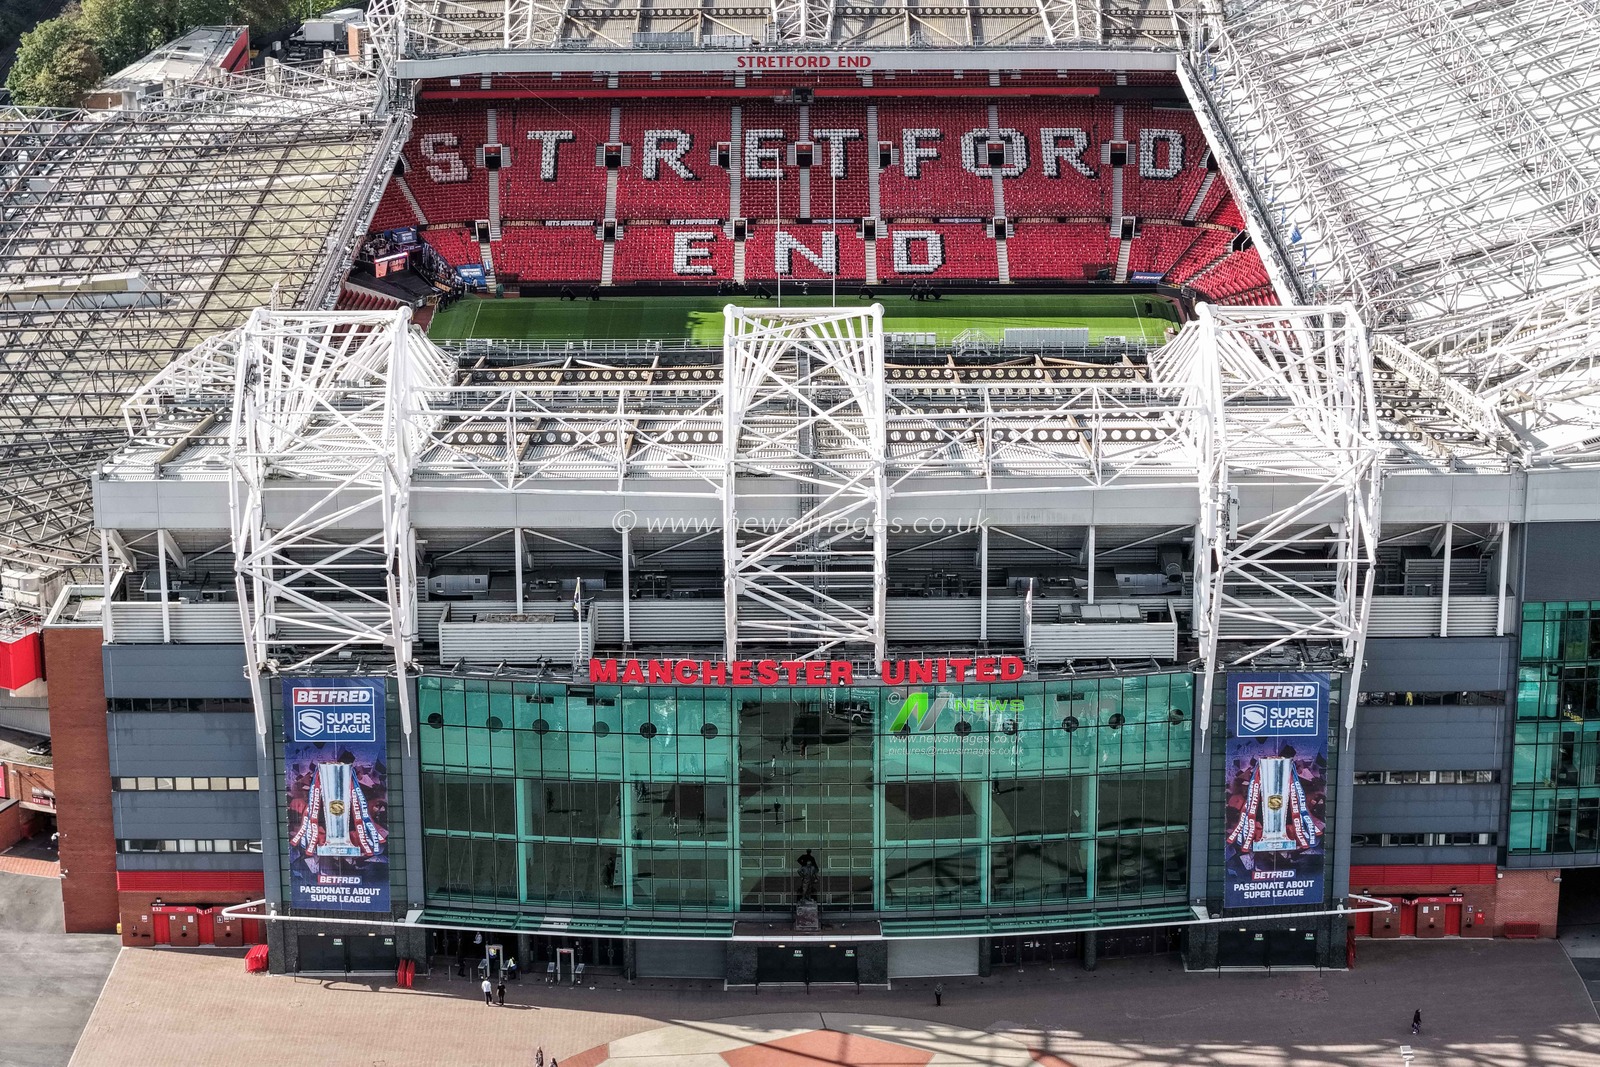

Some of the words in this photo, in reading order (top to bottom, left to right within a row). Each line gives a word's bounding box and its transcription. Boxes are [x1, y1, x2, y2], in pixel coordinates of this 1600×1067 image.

[737, 56, 831, 68] STRETFORD
[838, 56, 872, 68] END
[420, 127, 1186, 183] STRETFORD
[673, 229, 945, 276] END
[589, 658, 853, 685] MANCHESTER
[882, 656, 1024, 685] UNITED
[297, 690, 370, 703] BETFRED
[1241, 685, 1315, 698] BETFRED
[326, 712, 371, 724] SUPER
[1270, 707, 1314, 719] SUPER
[326, 724, 371, 734] LEAGUE
[1270, 719, 1314, 728] LEAGUE
[312, 788, 320, 819] BETFRED
[356, 787, 369, 818] BETFRED
[1249, 783, 1259, 814] BETFRED
[292, 816, 309, 844] BETFRED
[1229, 812, 1246, 840] BETFRED
[307, 823, 318, 853] BETFRED
[357, 824, 372, 853] BETFRED
[1243, 818, 1254, 849] BETFRED
[1294, 818, 1308, 848] BETFRED
[320, 875, 361, 884] BETFRED
[1254, 870, 1295, 879] BETFRED
[300, 885, 350, 895] PASSIONATE
[352, 887, 380, 896] ABOUT
[1233, 881, 1284, 891] PASSIONATE
[1286, 880, 1314, 889] ABOUT
[310, 894, 337, 903] SUPER
[339, 895, 371, 904] LEAGUE
[1244, 890, 1271, 899] SUPER
[1272, 889, 1304, 898] LEAGUE
